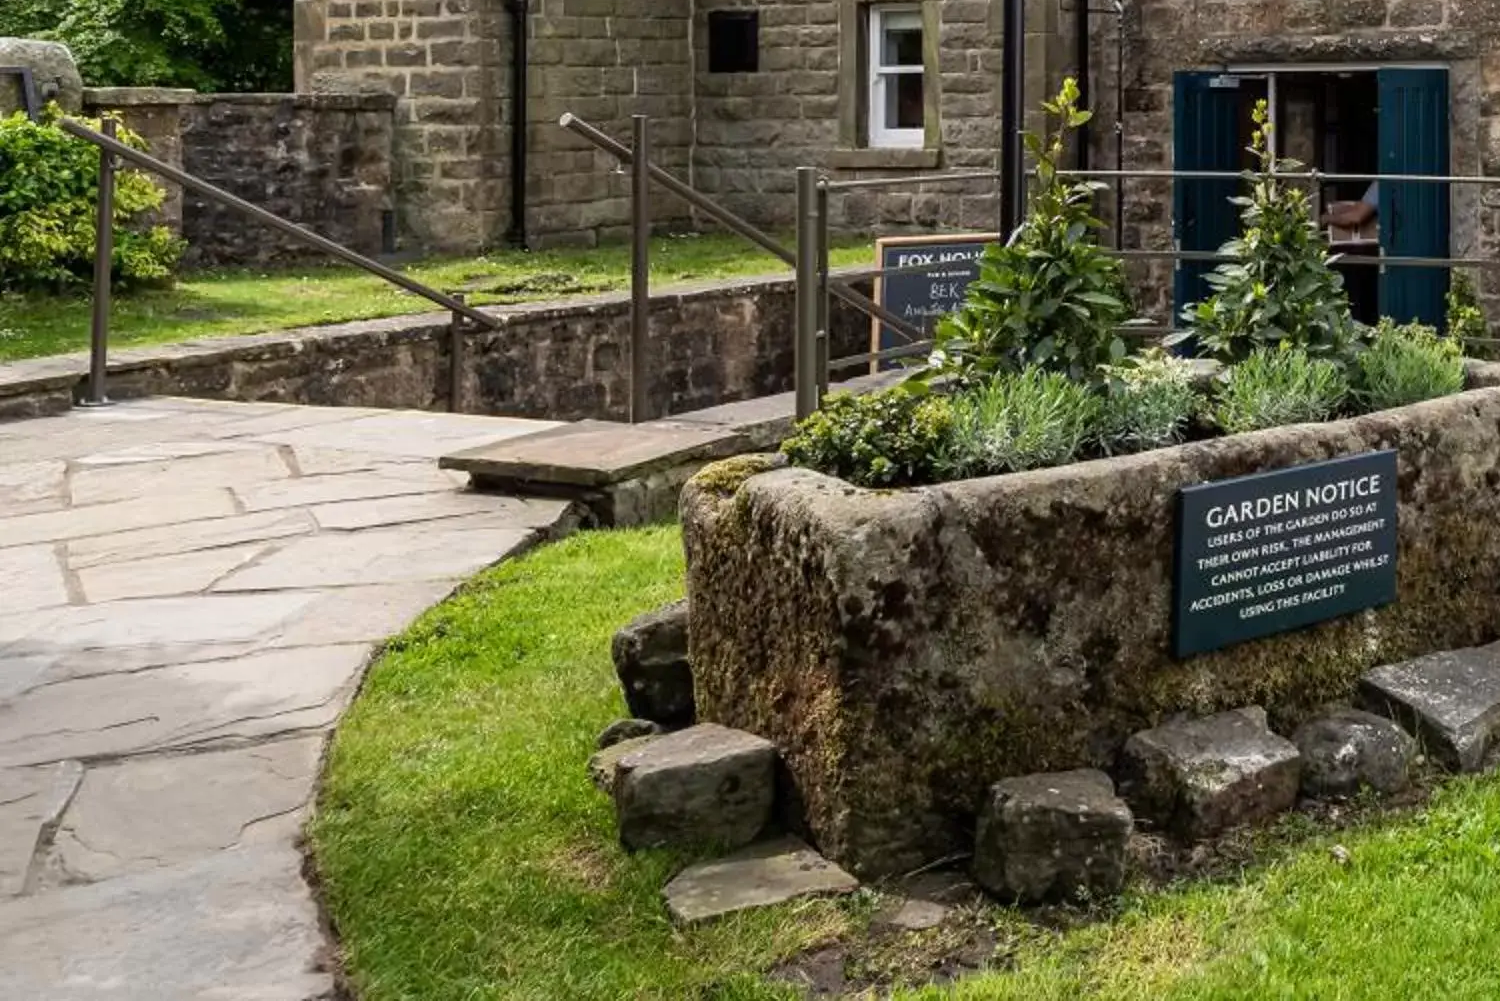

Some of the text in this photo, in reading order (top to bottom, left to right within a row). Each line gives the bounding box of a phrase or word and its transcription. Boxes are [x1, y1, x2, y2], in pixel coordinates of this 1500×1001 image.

[898, 254, 933, 268] FOX
[1206, 475, 1381, 528] GARDEN NOTICE
[1197, 554, 1229, 570] THEIR
[1232, 547, 1259, 562] OWN
[1292, 536, 1312, 548] THE
[1314, 519, 1385, 542] MANAGEMENT
[1208, 503, 1377, 547] USERS OF THE GARDEN DO SO AT
[1211, 540, 1372, 586] CANNOT ACCEPT LIABILITY FOR
[1258, 576, 1285, 595] LOSS
[1287, 574, 1303, 587] OR
[1305, 564, 1351, 584] DAMAGE
[1353, 554, 1389, 571] WHILST
[1240, 584, 1346, 619] USING THIS FACILITY
